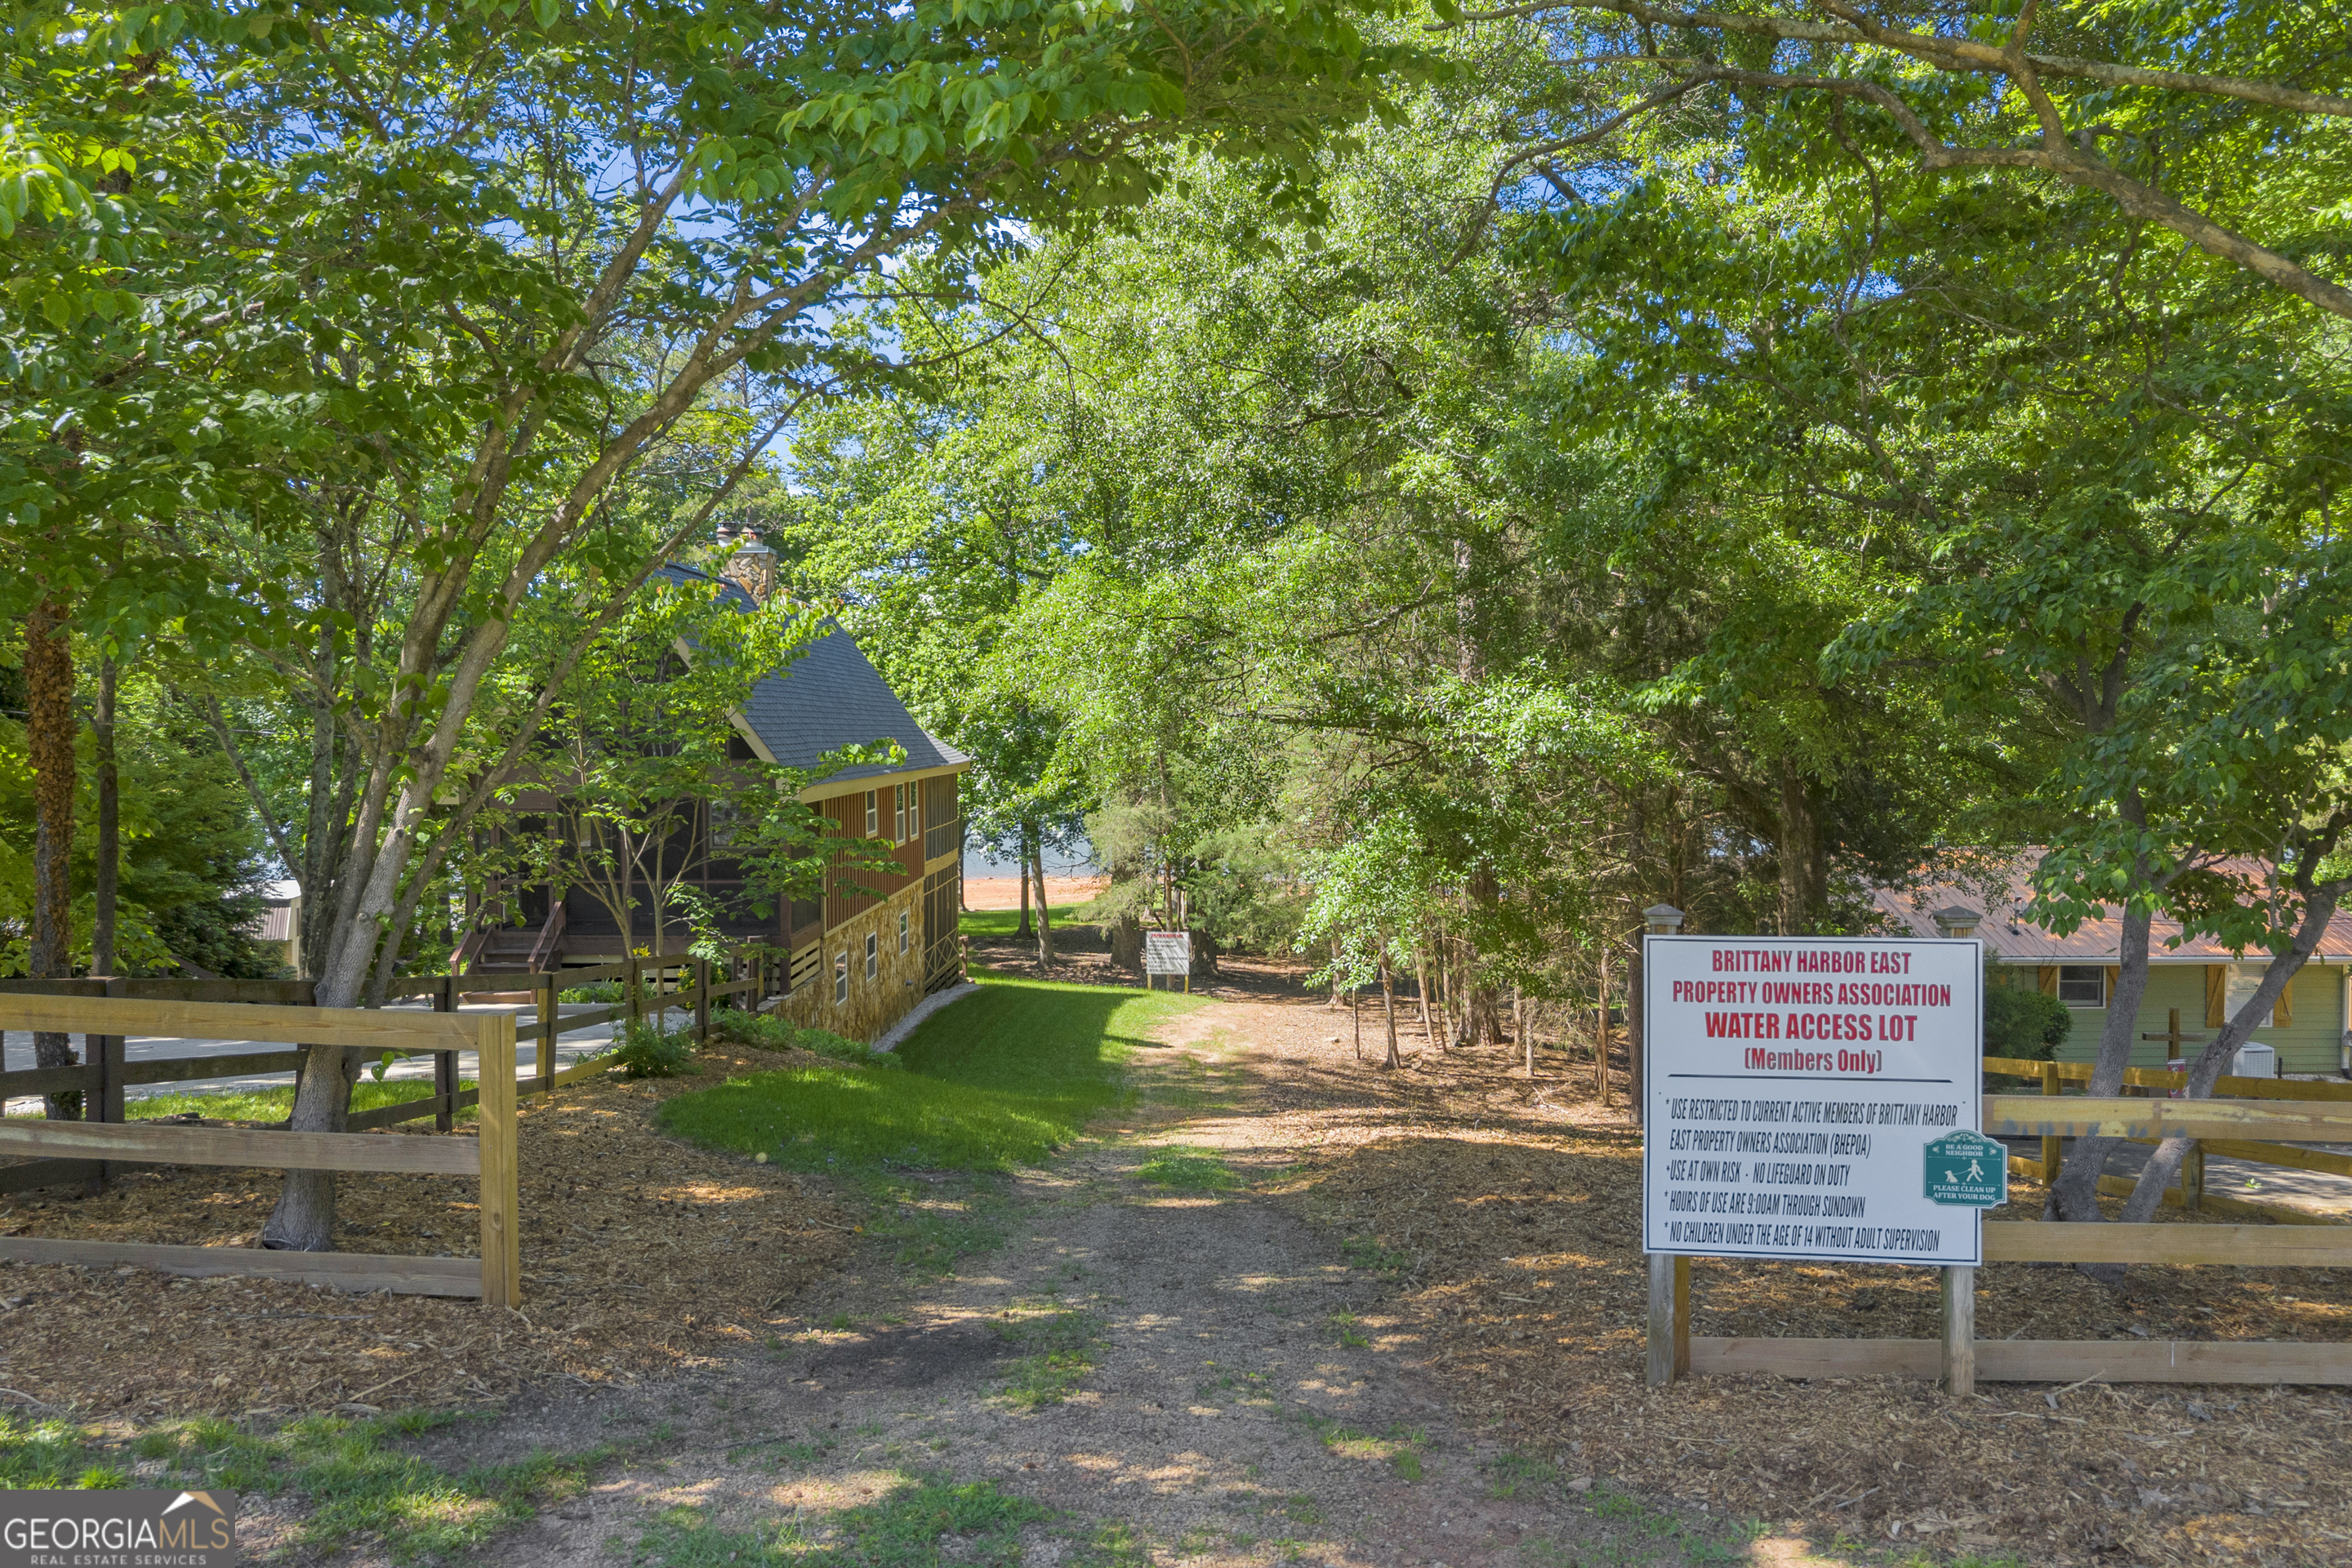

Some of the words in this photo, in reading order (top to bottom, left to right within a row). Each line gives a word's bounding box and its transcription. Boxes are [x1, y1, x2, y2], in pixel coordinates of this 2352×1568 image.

[1712, 950, 1793, 972] BRITTANY
[1797, 951, 1865, 973] HARBOR
[1870, 951, 1912, 974] EAST
[1673, 980, 1757, 1004] PROPERTY
[1762, 982, 1833, 1005] OWNERS
[1838, 982, 1951, 1007] ASSOCIATION
[1704, 1012, 1780, 1039] WATER
[1785, 1013, 1873, 1041] ACCESS
[1878, 1014, 1918, 1041] LOT
[1744, 1047, 1833, 1071] (Members
[1838, 1049, 1882, 1074] Only)
[1671, 1098, 1688, 1120] USE
[1688, 1098, 1739, 1121] RESTRICTED
[1740, 1100, 1752, 1121] TO
[1752, 1100, 1792, 1123] CURRENT
[1791, 1101, 1823, 1123] ACTIVE
[1823, 1102, 1865, 1125] MEMBERS
[1865, 1102, 1878, 1125] OF
[1878, 1103, 1922, 1125] BRITTANY
[1922, 1104, 1958, 1126] HARBOR
[1669, 1129, 1692, 1151] EAST
[1692, 1129, 1736, 1152] PROPERTY
[1736, 1131, 1772, 1153] OWNERS
[1772, 1132, 1829, 1155] ASSOCIATION
[1829, 1133, 1872, 1160] (BHEPOA)
[1686, 1160, 1700, 1182] AT
[1699, 1160, 1721, 1183] OWN
[1721, 1161, 1742, 1183] RISK
[1752, 1162, 1766, 1184] NO
[1766, 1163, 1813, 1185] LIFEGUARD
[1813, 1164, 1827, 1186] ON
[1827, 1165, 1851, 1187] DUTY
[1960, 1185, 1984, 1193] CLEAN
[1669, 1190, 1699, 1212] HOURS
[1699, 1192, 1711, 1213] OF
[1711, 1192, 1729, 1214] USE
[1728, 1192, 1747, 1214] ARE
[1747, 1193, 1781, 1215] 9:00AM
[1781, 1194, 1822, 1217] THROUGH
[1822, 1196, 1866, 1218] SUNDOWN
[1669, 1221, 1682, 1242] NO
[1683, 1222, 1725, 1244] CHILDREN
[1726, 1223, 1754, 1245] UNDER
[1756, 1224, 1772, 1245] THE
[1772, 1225, 1791, 1246] AGE
[1791, 1225, 1803, 1247] OF
[1803, 1226, 1814, 1247] 14
[1815, 1226, 1854, 1249] WITHOUT
[1853, 1227, 1883, 1250] ADULT
[1882, 1227, 1940, 1251] SUPERVISION
